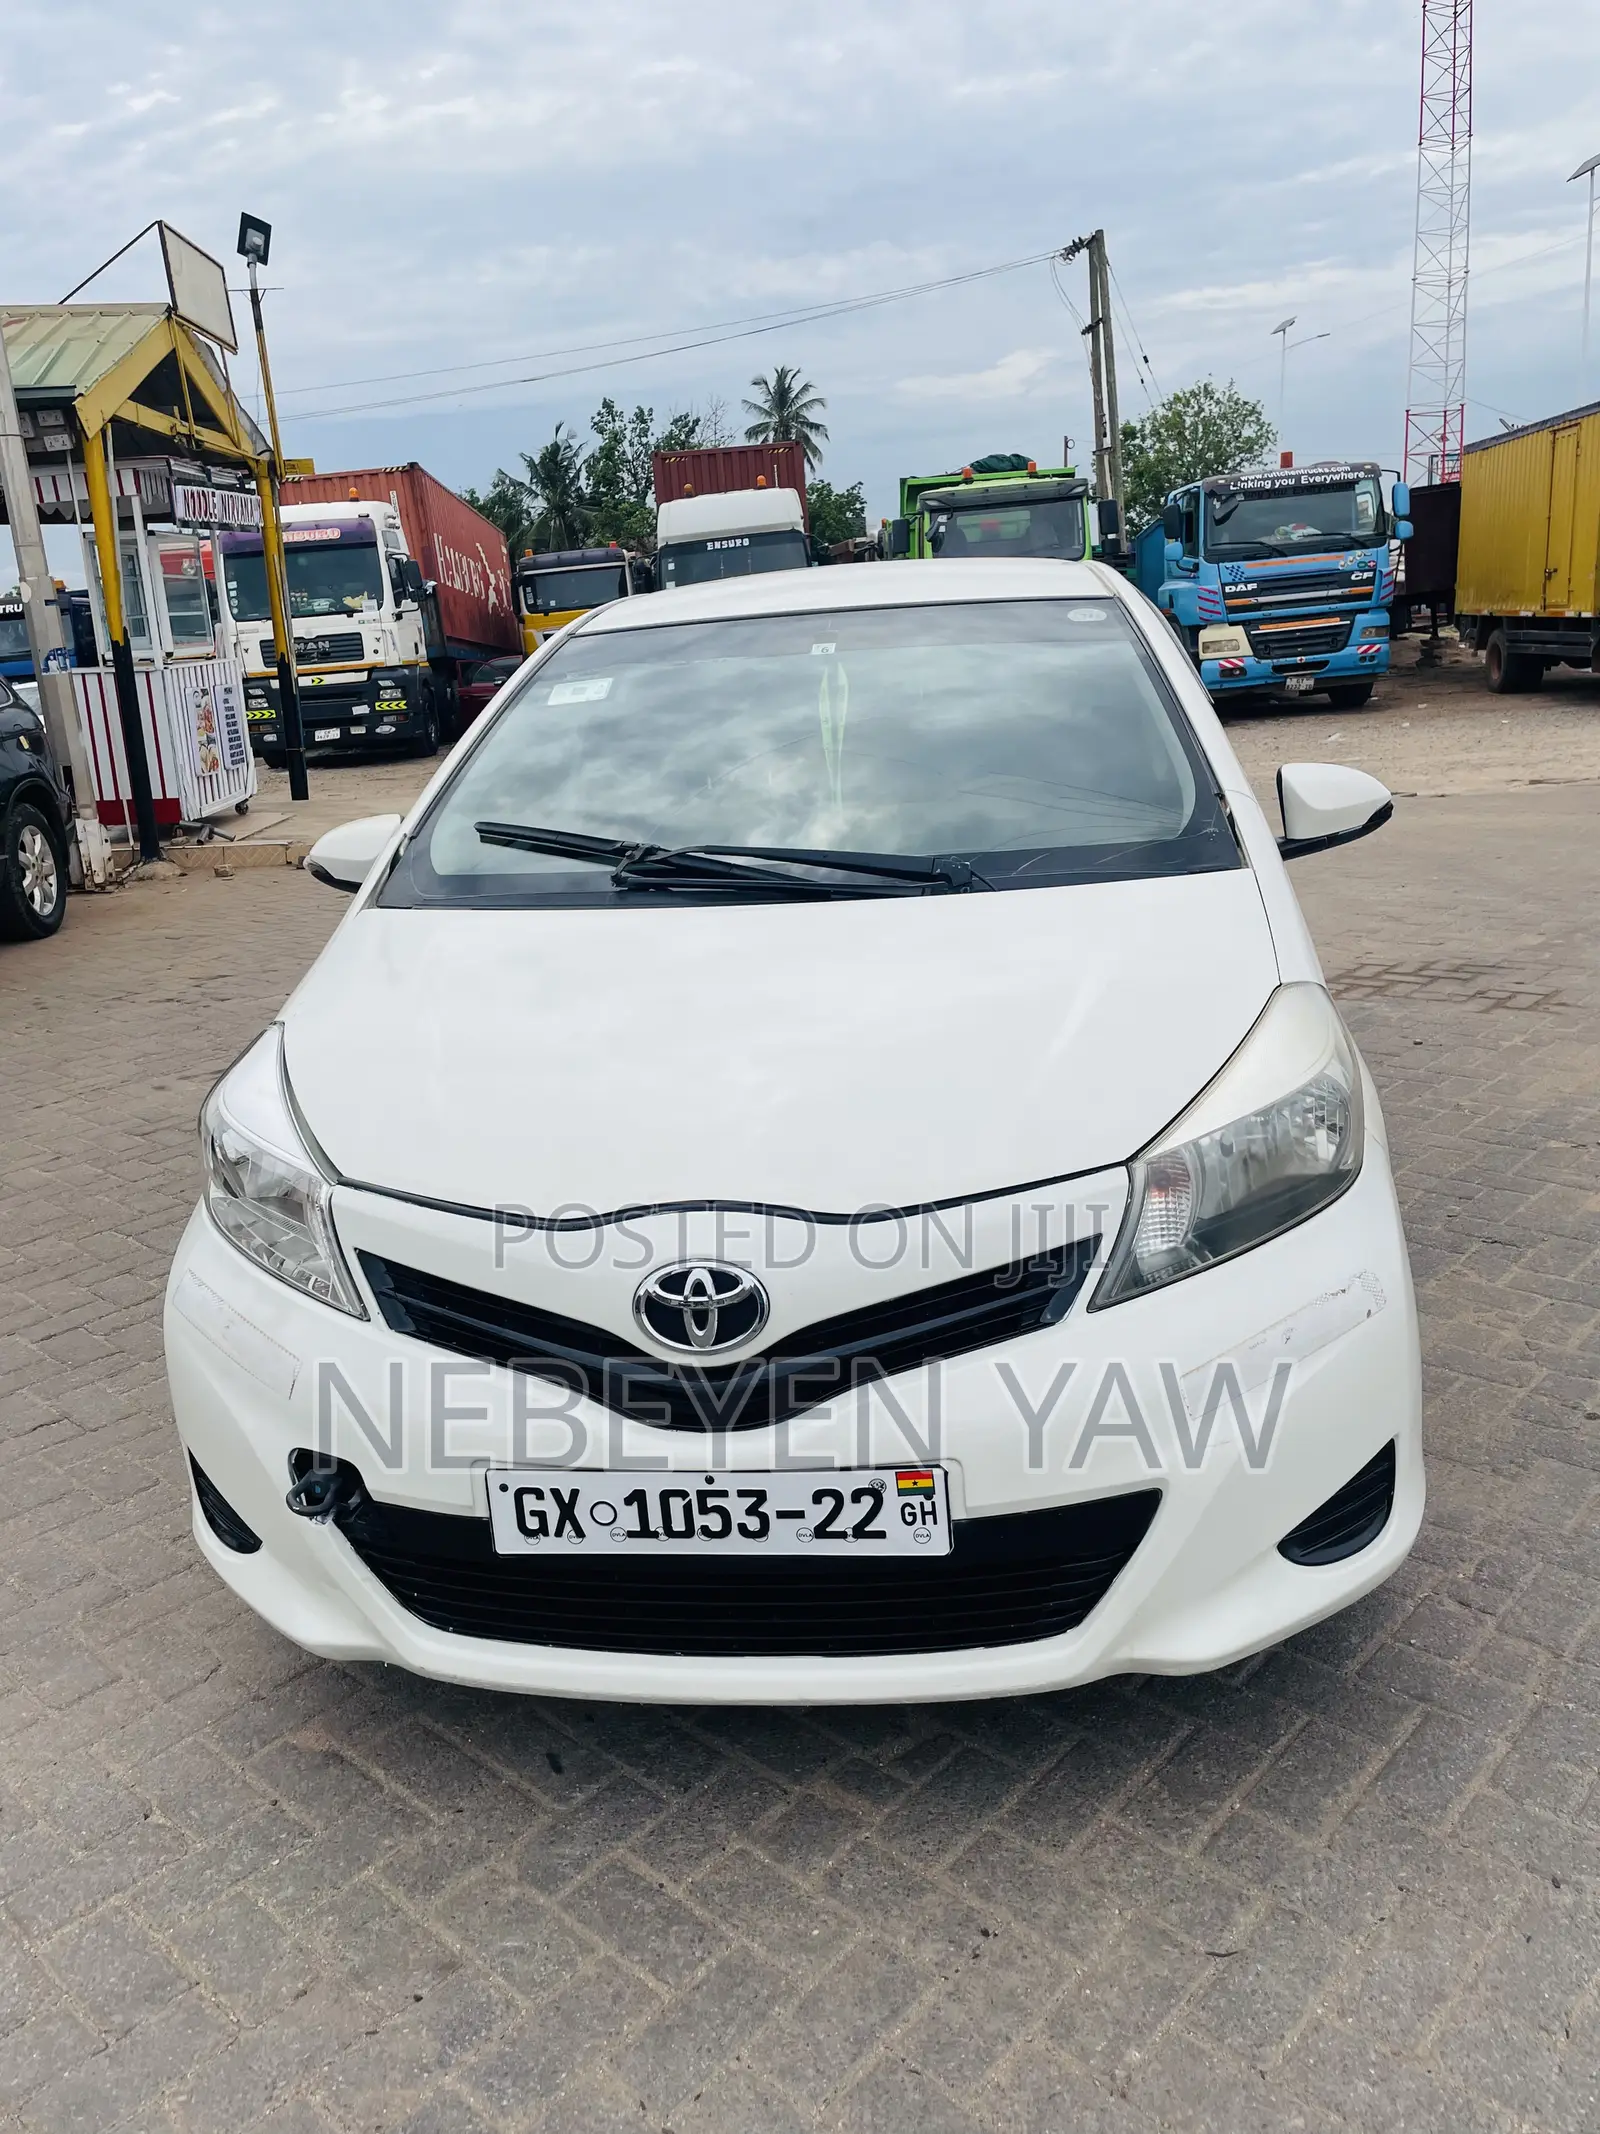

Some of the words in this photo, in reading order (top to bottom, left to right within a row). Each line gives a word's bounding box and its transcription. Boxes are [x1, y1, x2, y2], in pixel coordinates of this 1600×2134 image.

[1230, 479, 1272, 490] Linking
[1274, 478, 1295, 488] you
[183, 488, 219, 522] NOODLE
[706, 538, 750, 551] ENSURO
[1350, 571, 1374, 581] CF
[1224, 583, 1258, 593] DAF
[294, 641, 330, 651] MAN
[514, 1486, 586, 1538] GX
[623, 1487, 887, 1540] 1053-22
[901, 1500, 938, 1526] GH
